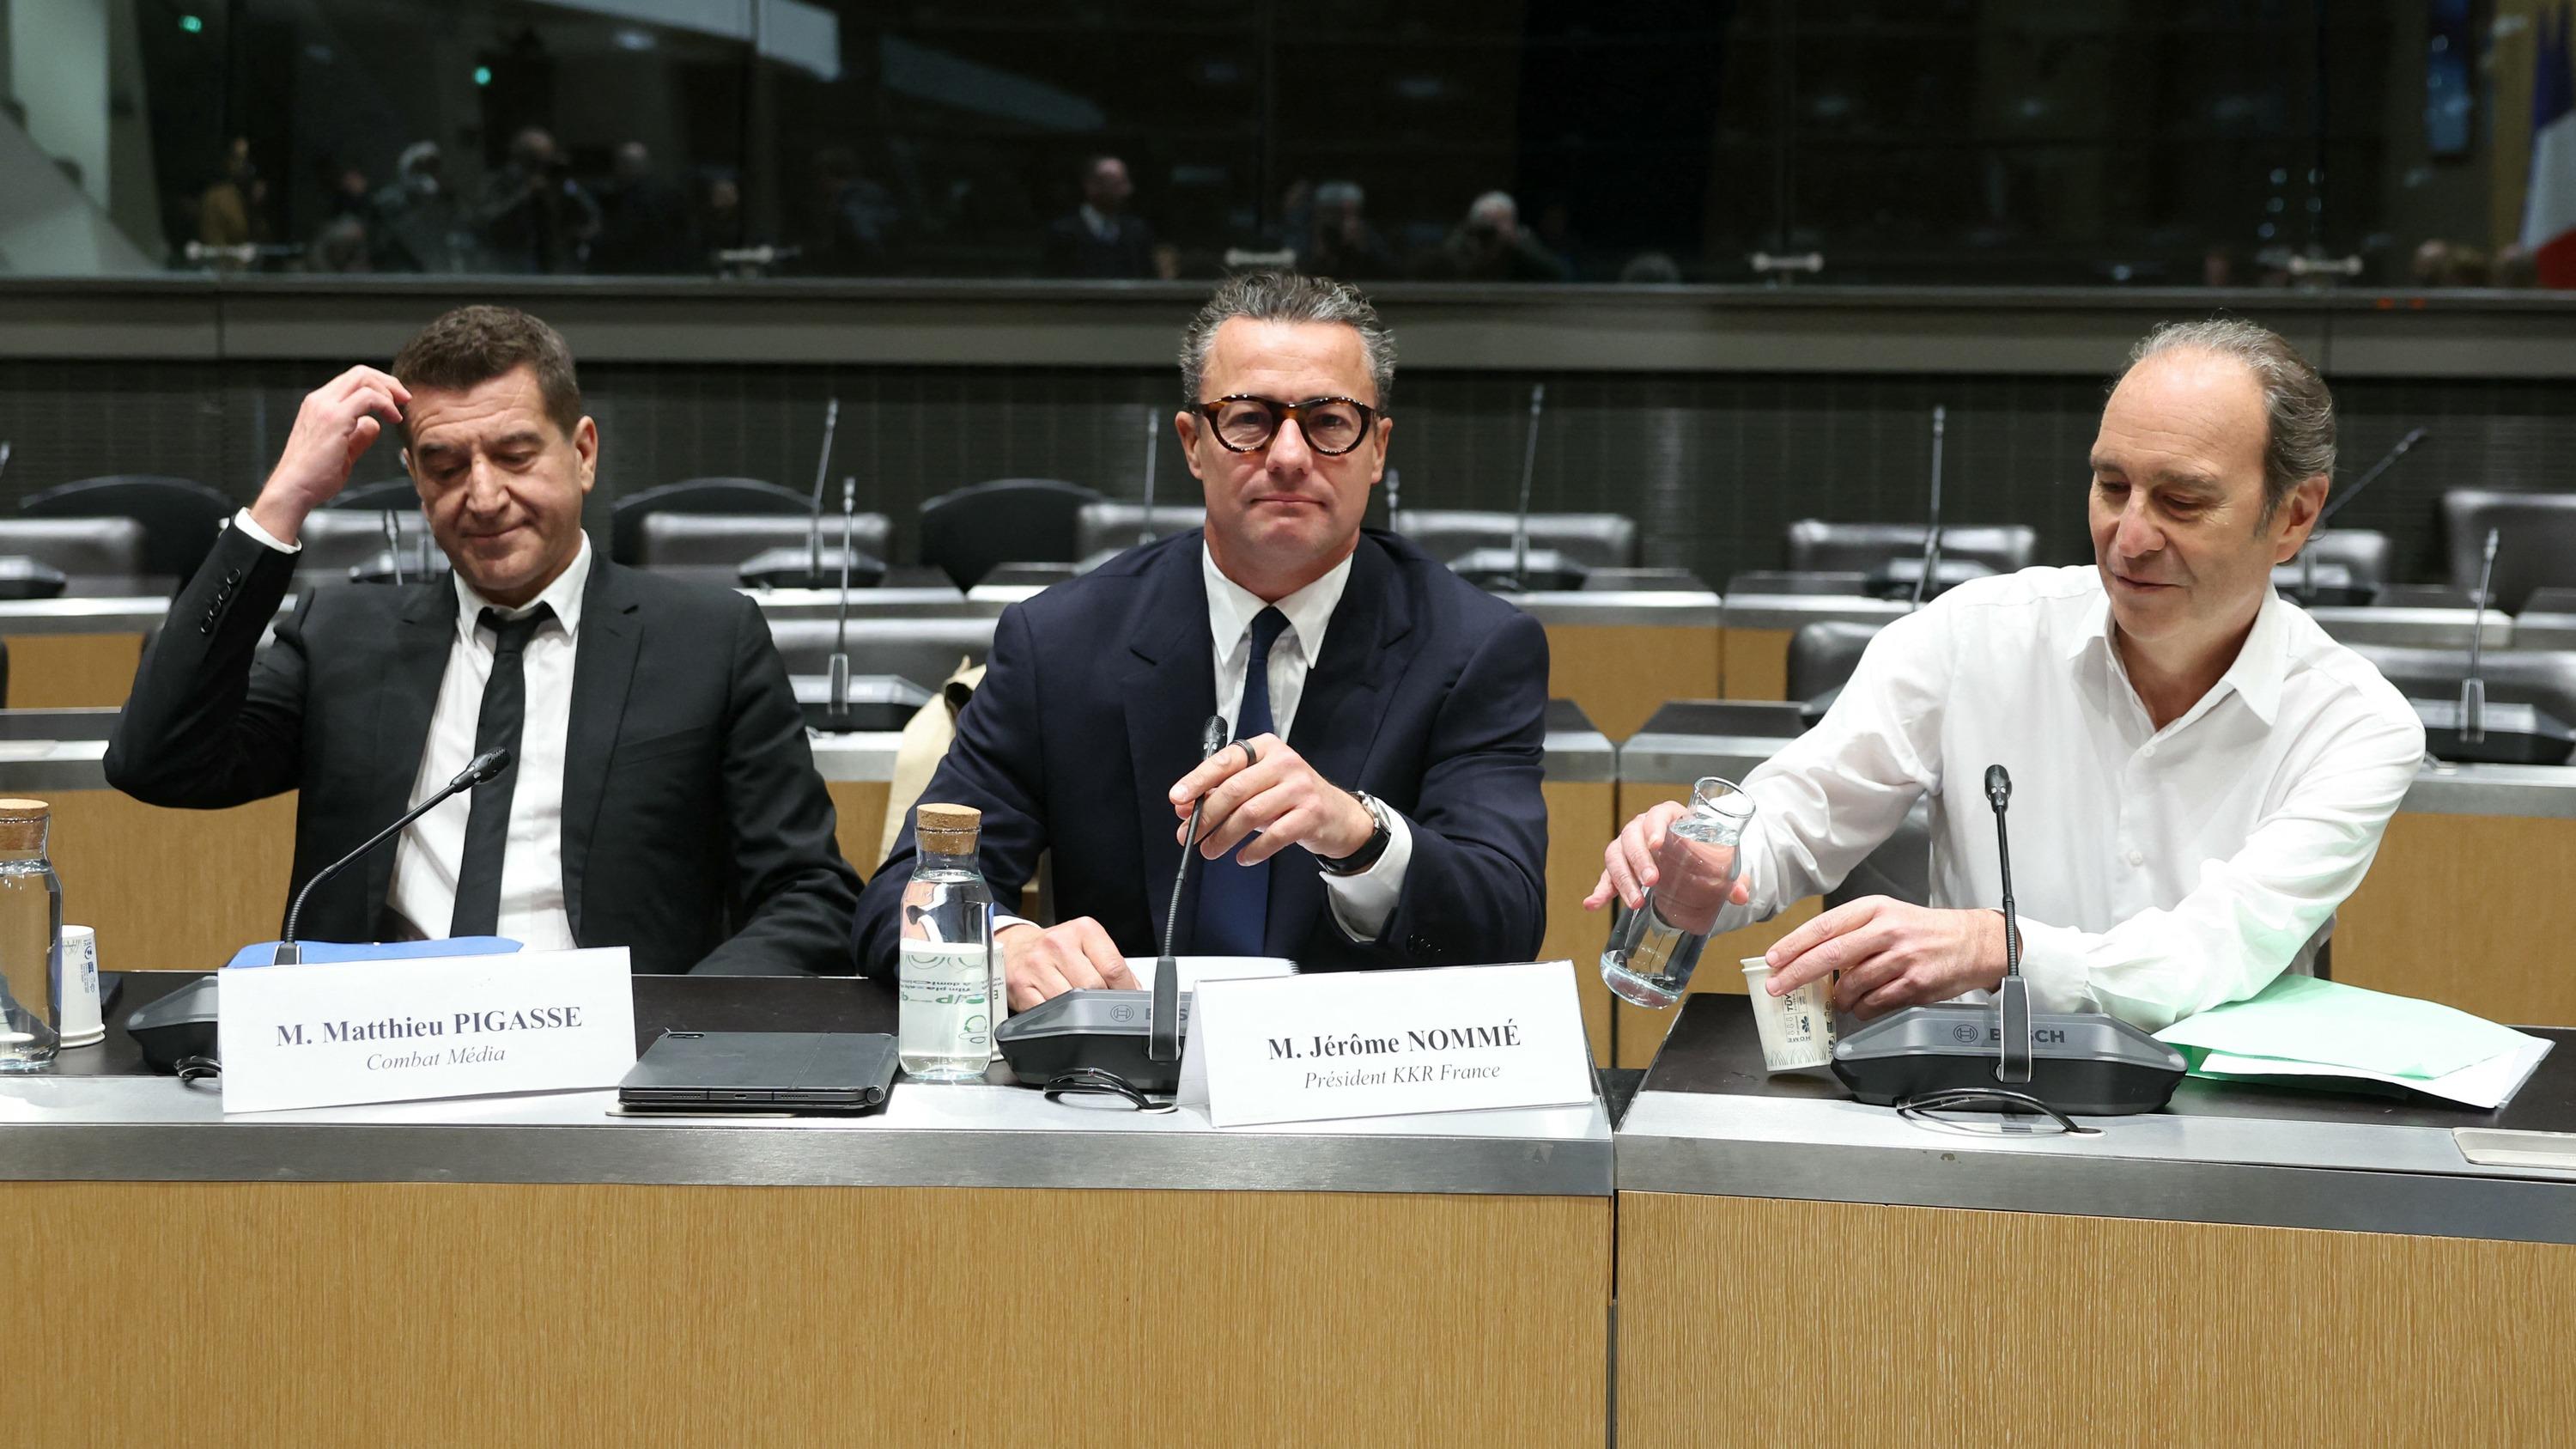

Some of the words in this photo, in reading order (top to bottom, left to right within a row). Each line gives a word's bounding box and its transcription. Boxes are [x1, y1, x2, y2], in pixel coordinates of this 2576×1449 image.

[1784, 993, 1794, 1012] TÜV
[276, 1024, 312, 1046] M.
[323, 1017, 443, 1044] Matthieu
[454, 1007, 583, 1034] PIGASSE
[1267, 1037, 1302, 1060] M.
[1309, 1033, 1400, 1058] Jérôme
[1406, 1018, 1522, 1052] NOMMÉ
[367, 1051, 440, 1071] Combat
[447, 1045, 506, 1066] Média
[1305, 1068, 1387, 1089] Président
[1393, 1065, 1434, 1084] KKR
[1440, 1063, 1501, 1081] France
